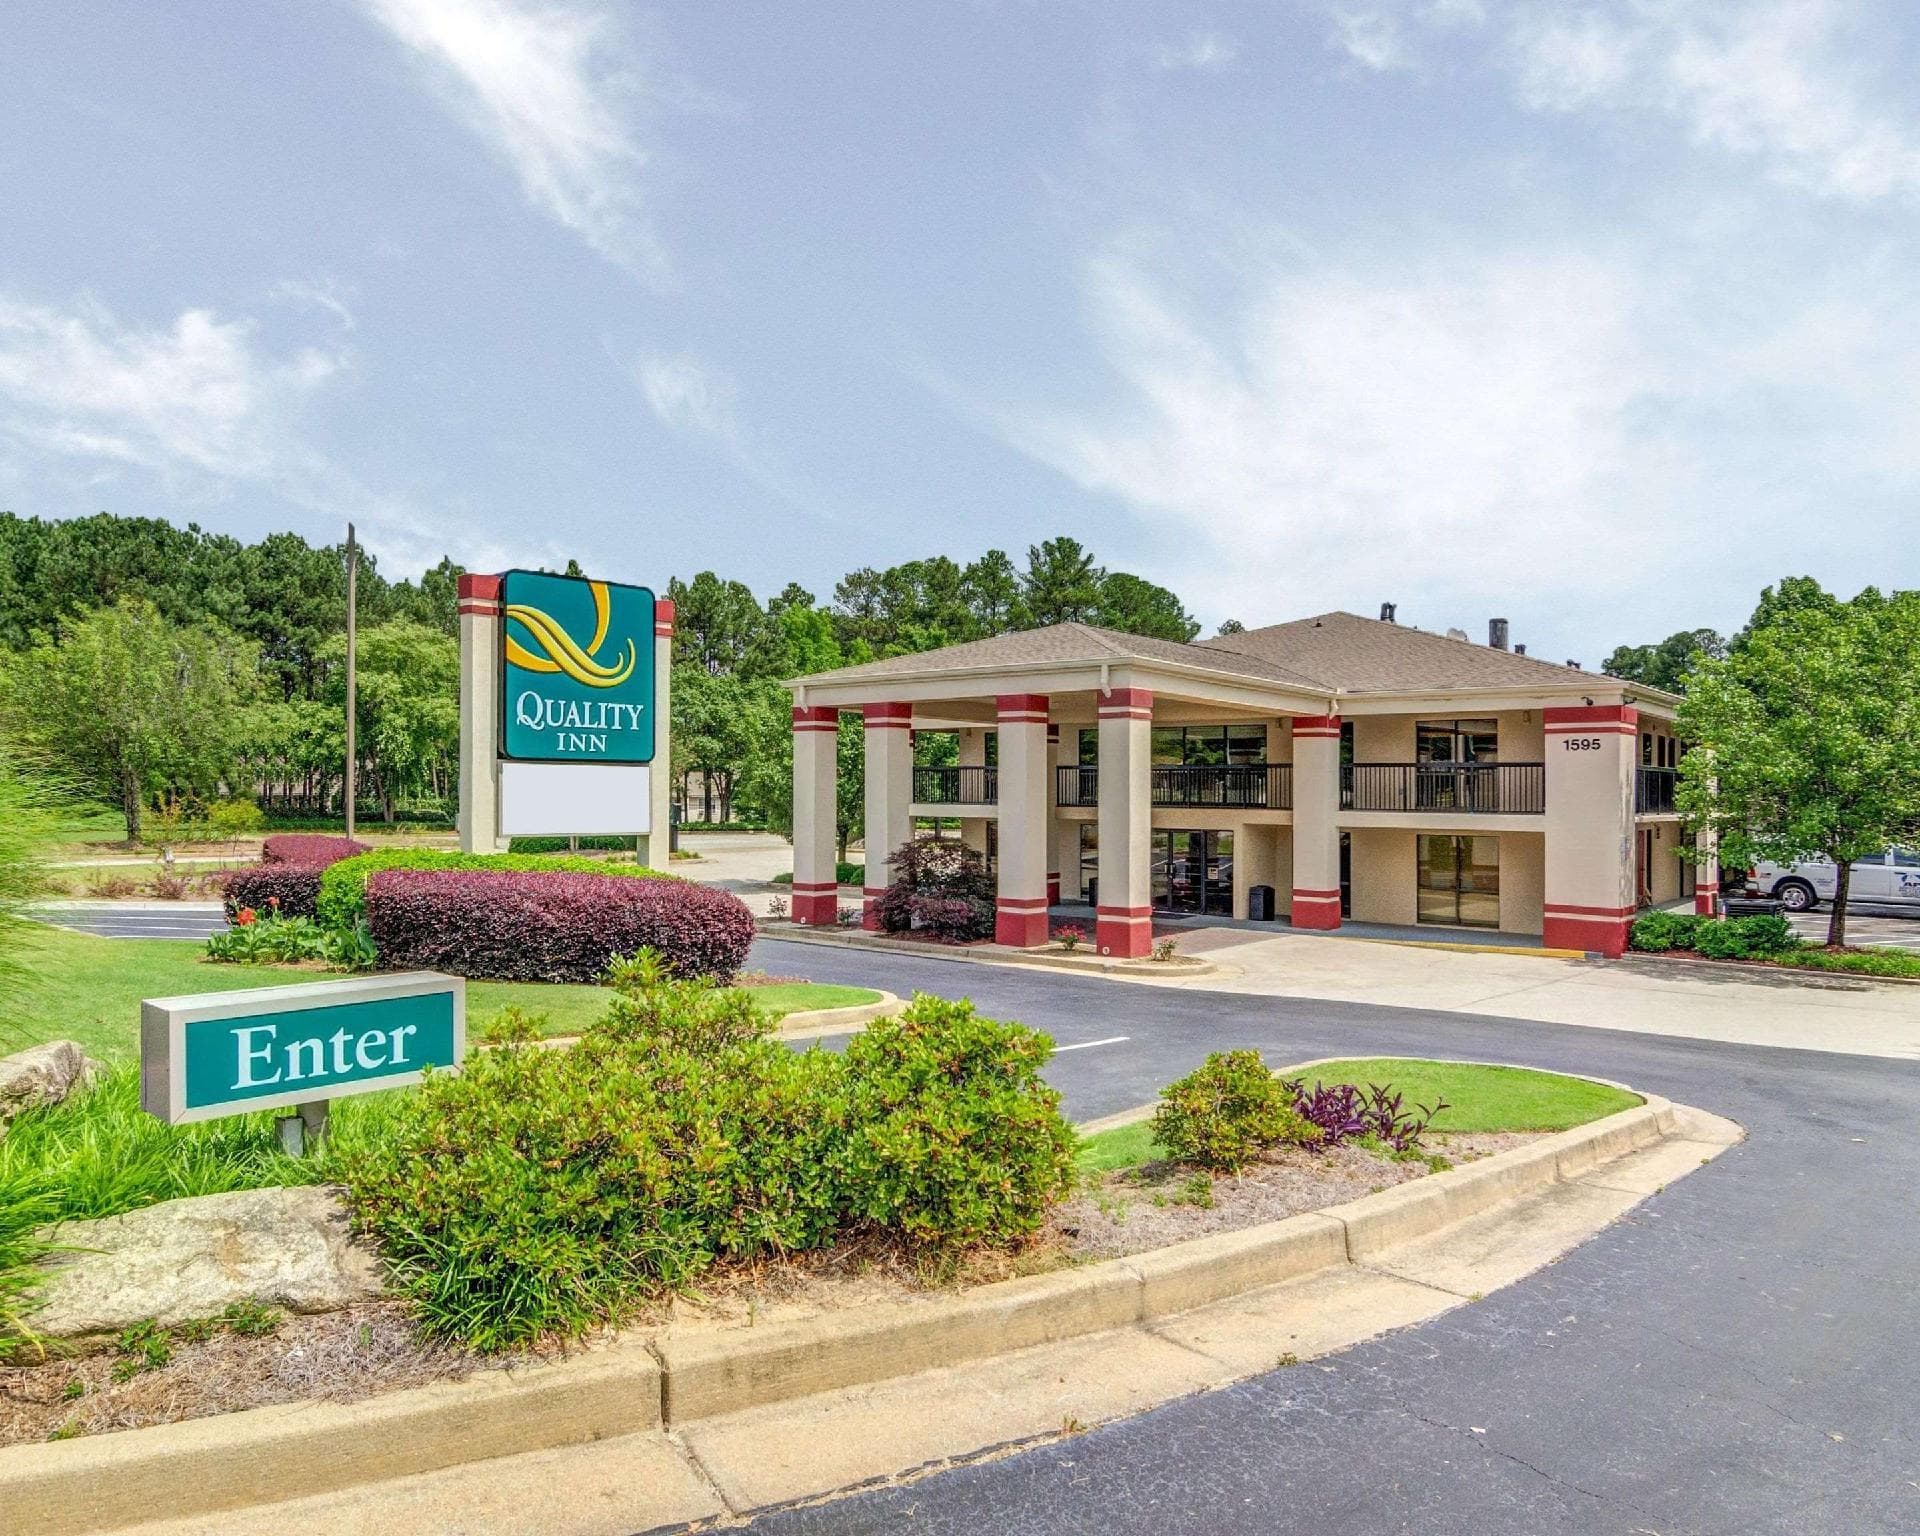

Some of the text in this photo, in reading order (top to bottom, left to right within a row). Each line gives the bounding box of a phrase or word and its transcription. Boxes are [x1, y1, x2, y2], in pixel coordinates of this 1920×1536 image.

[517, 691, 643, 731] QUALITY
[557, 733, 607, 752] INN
[1563, 738, 1601, 751] 1595
[230, 1024, 417, 1090] Enter
